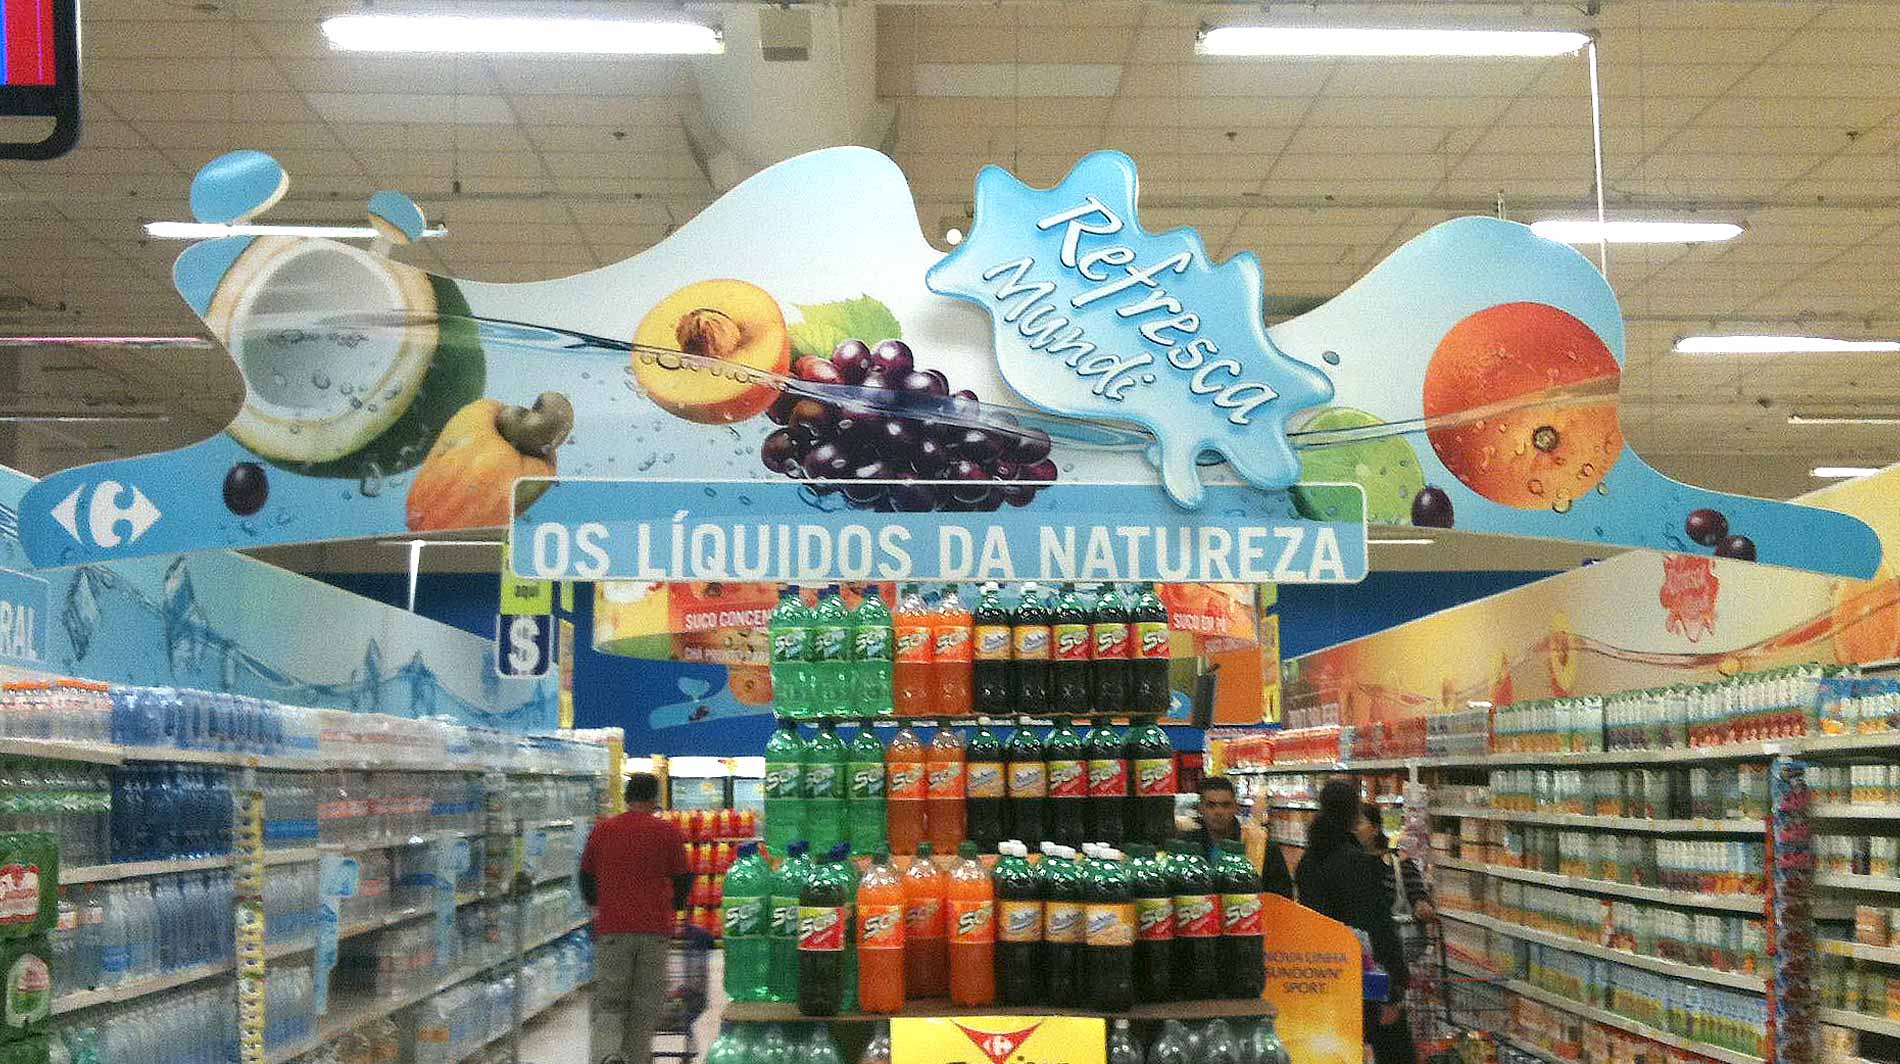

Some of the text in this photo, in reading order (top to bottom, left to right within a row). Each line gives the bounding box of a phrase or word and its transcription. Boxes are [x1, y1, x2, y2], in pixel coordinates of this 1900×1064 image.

[983, 256, 1156, 401] Mundi
[1036, 196, 1280, 425] Refresca
[533, 509, 1347, 582] OS LÍQUIDOS DA NATUREZA
